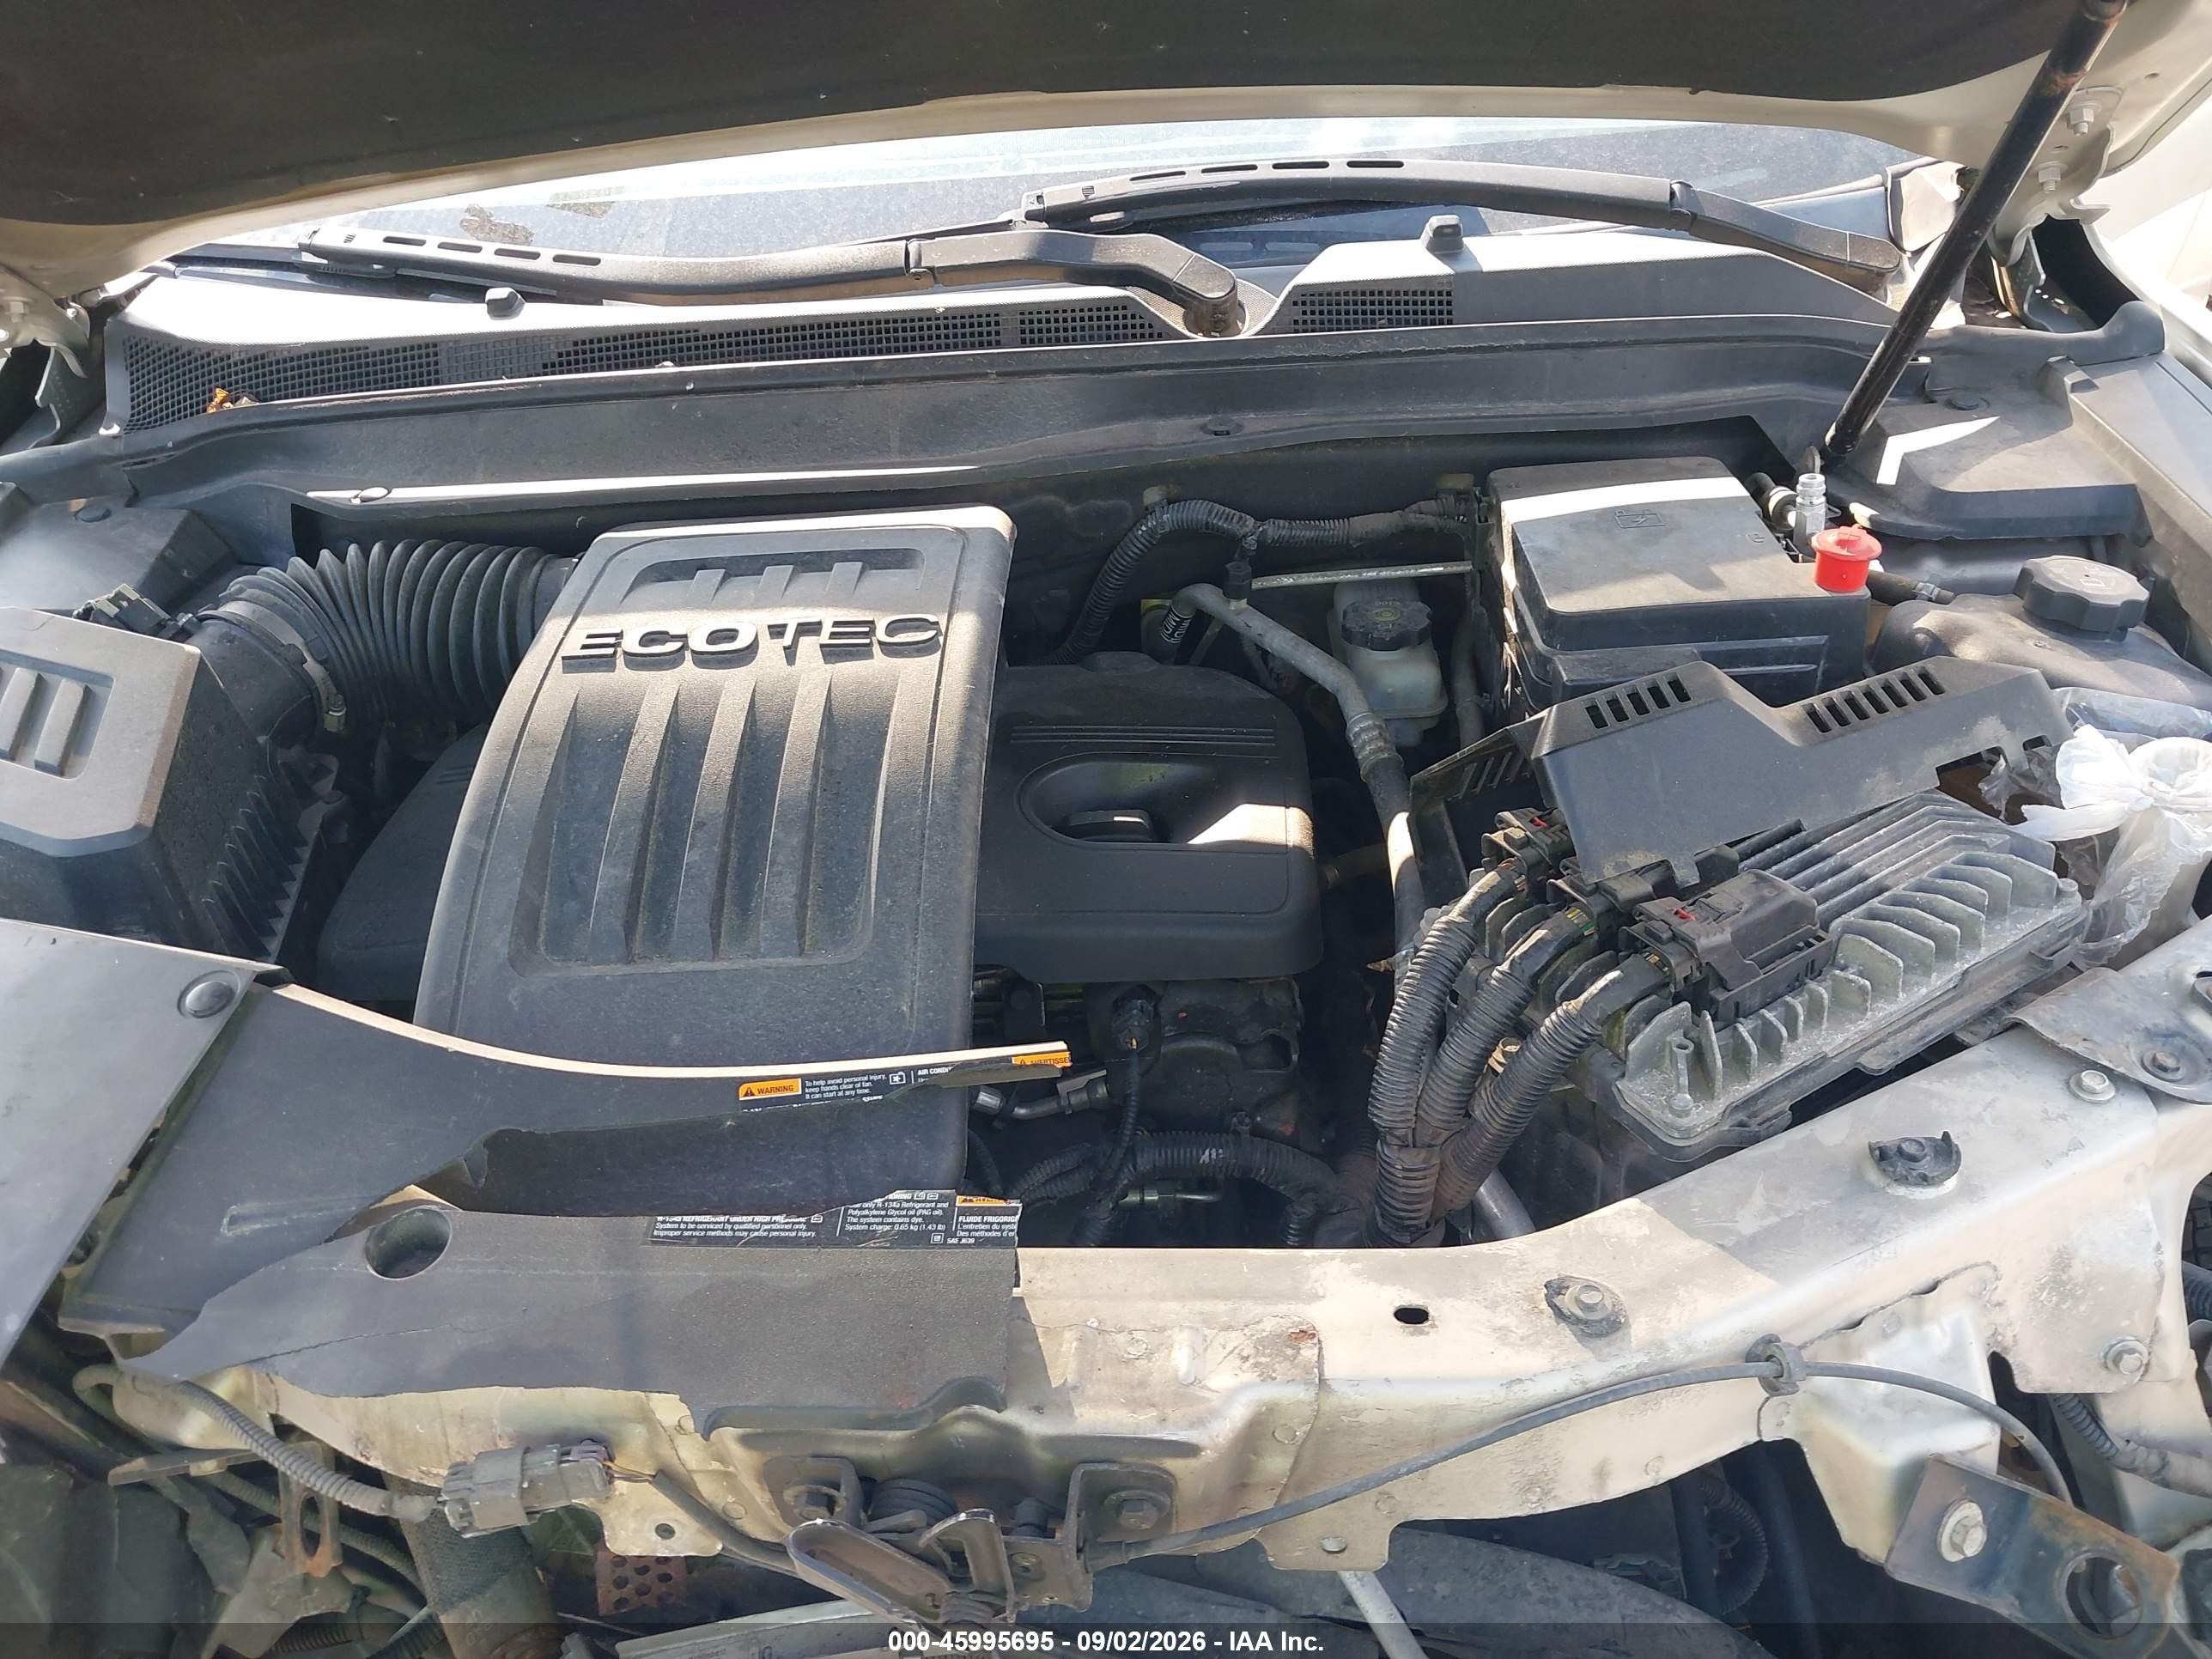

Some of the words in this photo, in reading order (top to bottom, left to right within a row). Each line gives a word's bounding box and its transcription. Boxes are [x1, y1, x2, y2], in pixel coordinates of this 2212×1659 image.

[562, 614, 942, 668] ECOTEC
[843, 1075, 868, 1084] personal
[757, 1085, 794, 1094] WARNING
